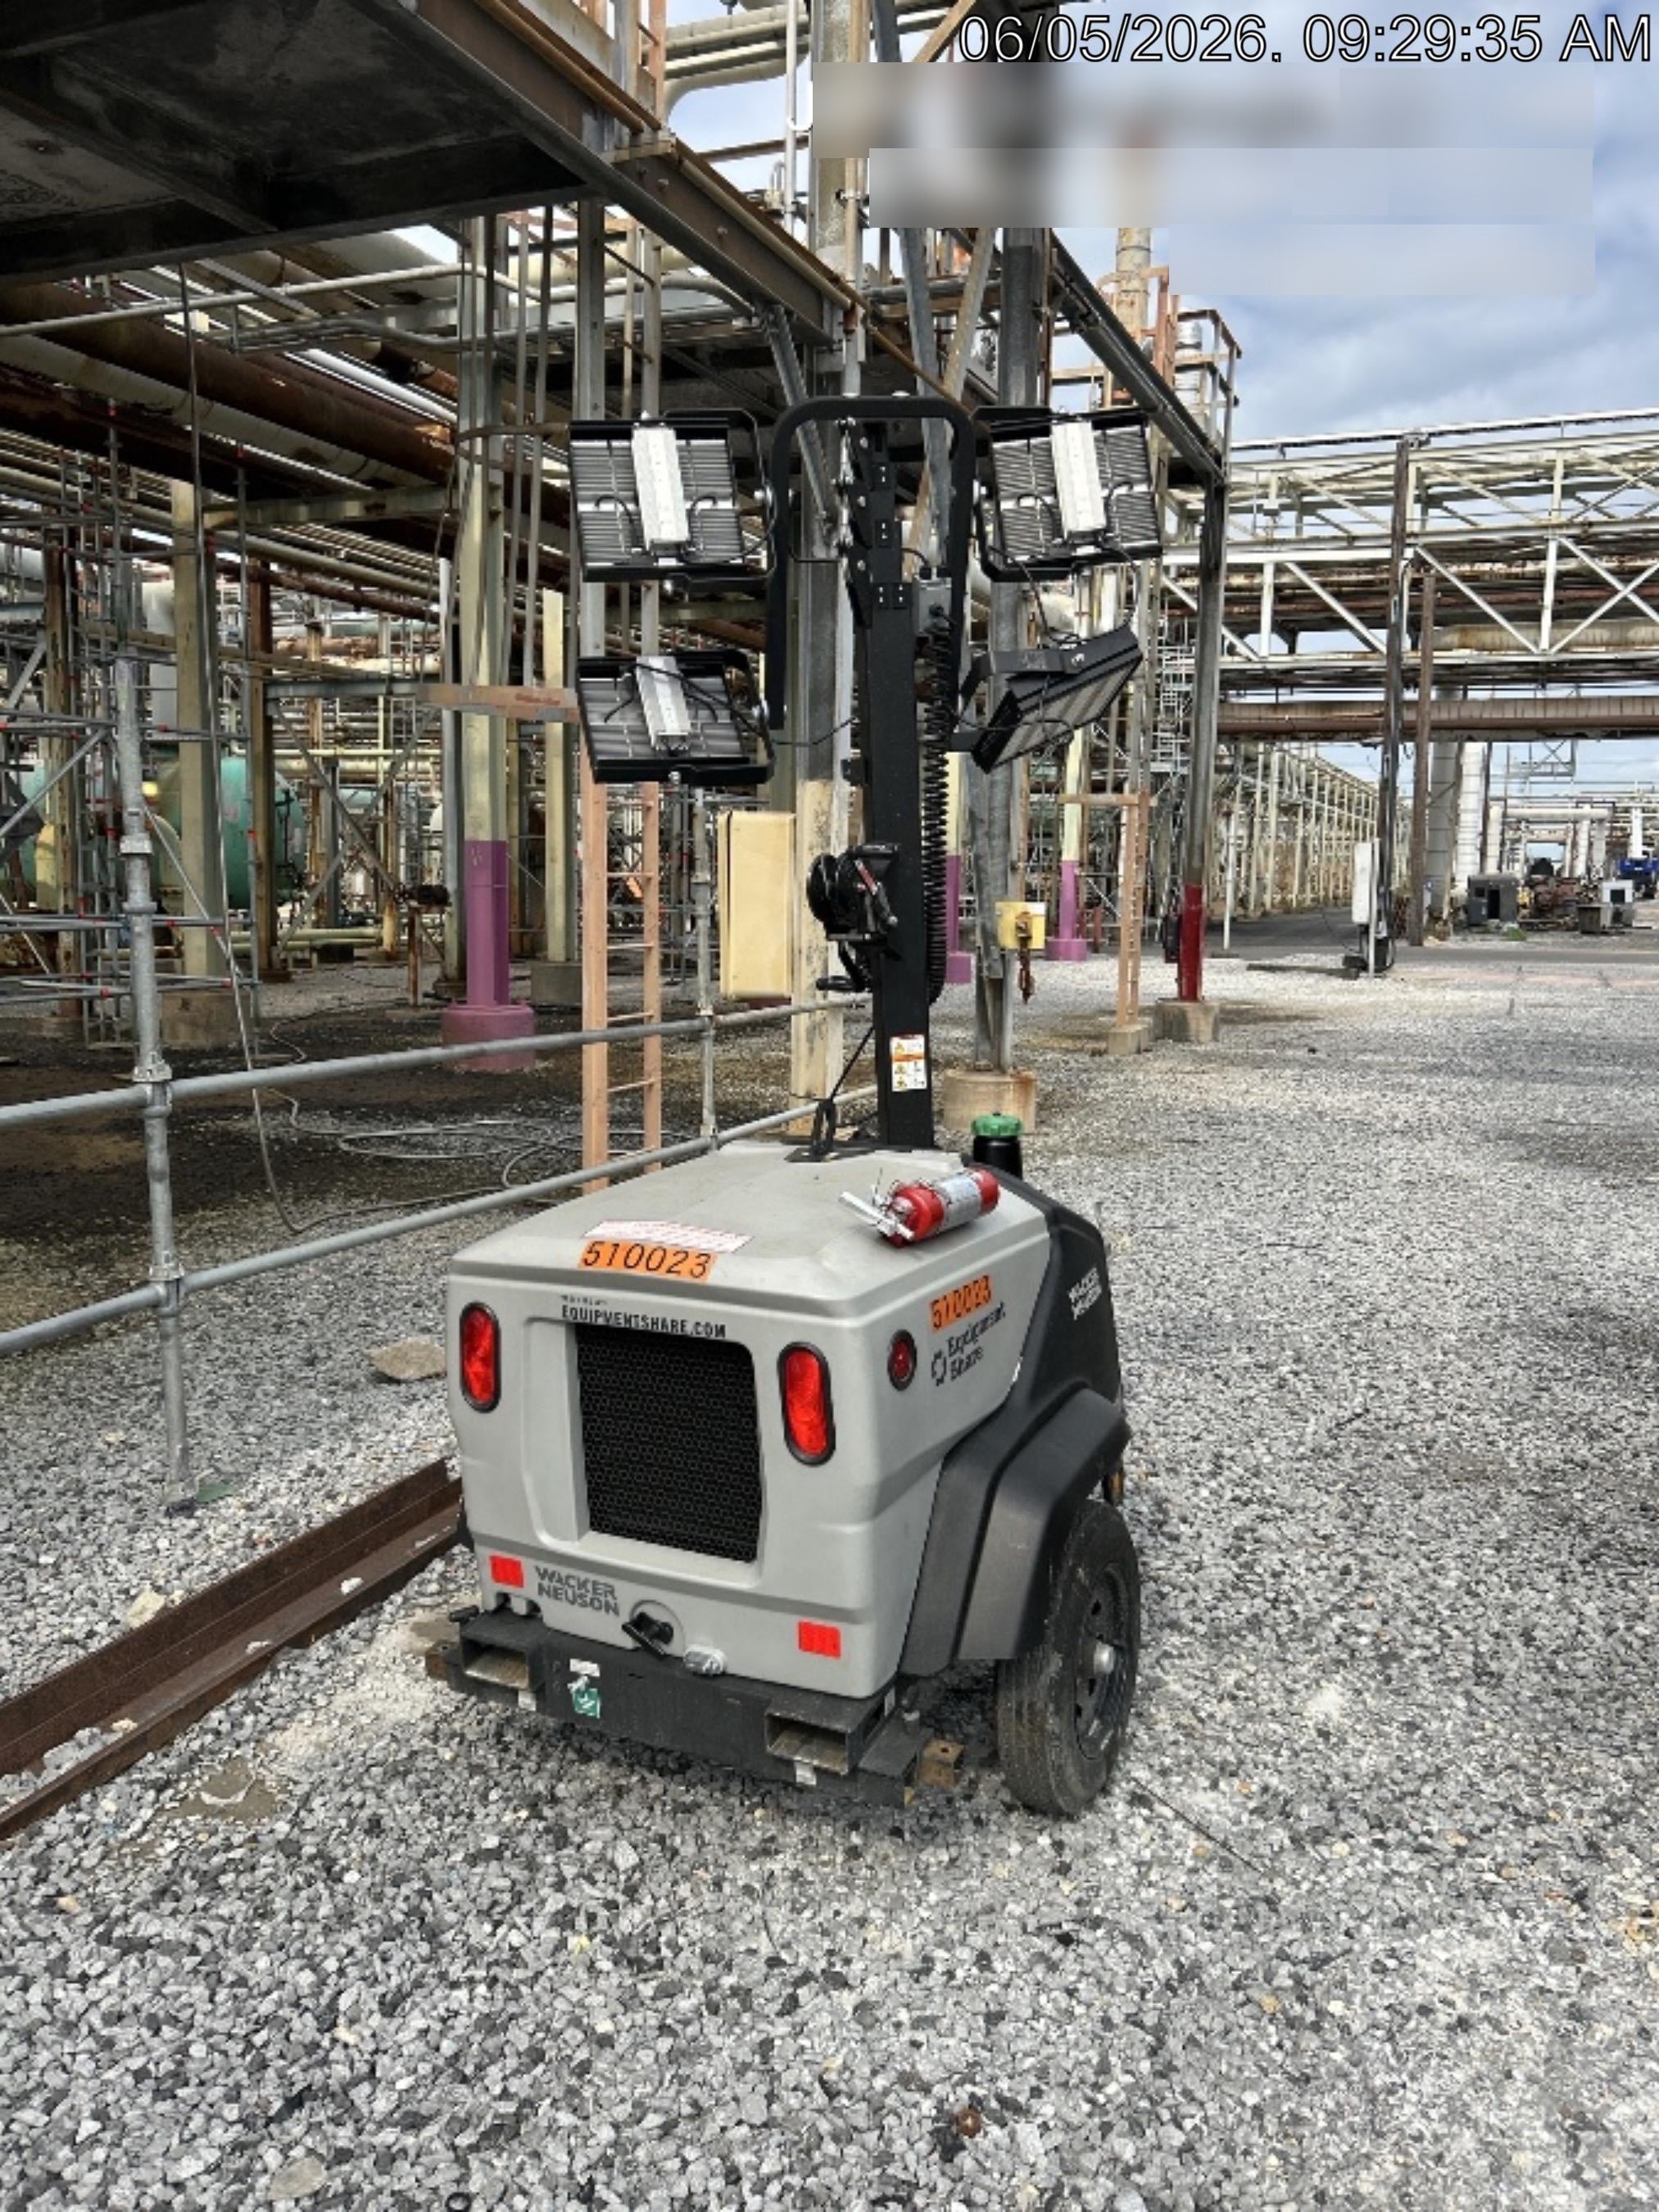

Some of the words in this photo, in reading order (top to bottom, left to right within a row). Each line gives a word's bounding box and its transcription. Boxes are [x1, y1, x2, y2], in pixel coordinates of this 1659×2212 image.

[582, 1240, 712, 1279] 510023
[931, 1275, 991, 1330] 510023
[562, 1304, 727, 1338] EQUIPMENTSHARE.COM
[534, 1565, 618, 1601] WACKER
[537, 1582, 620, 1617] NEUSON
